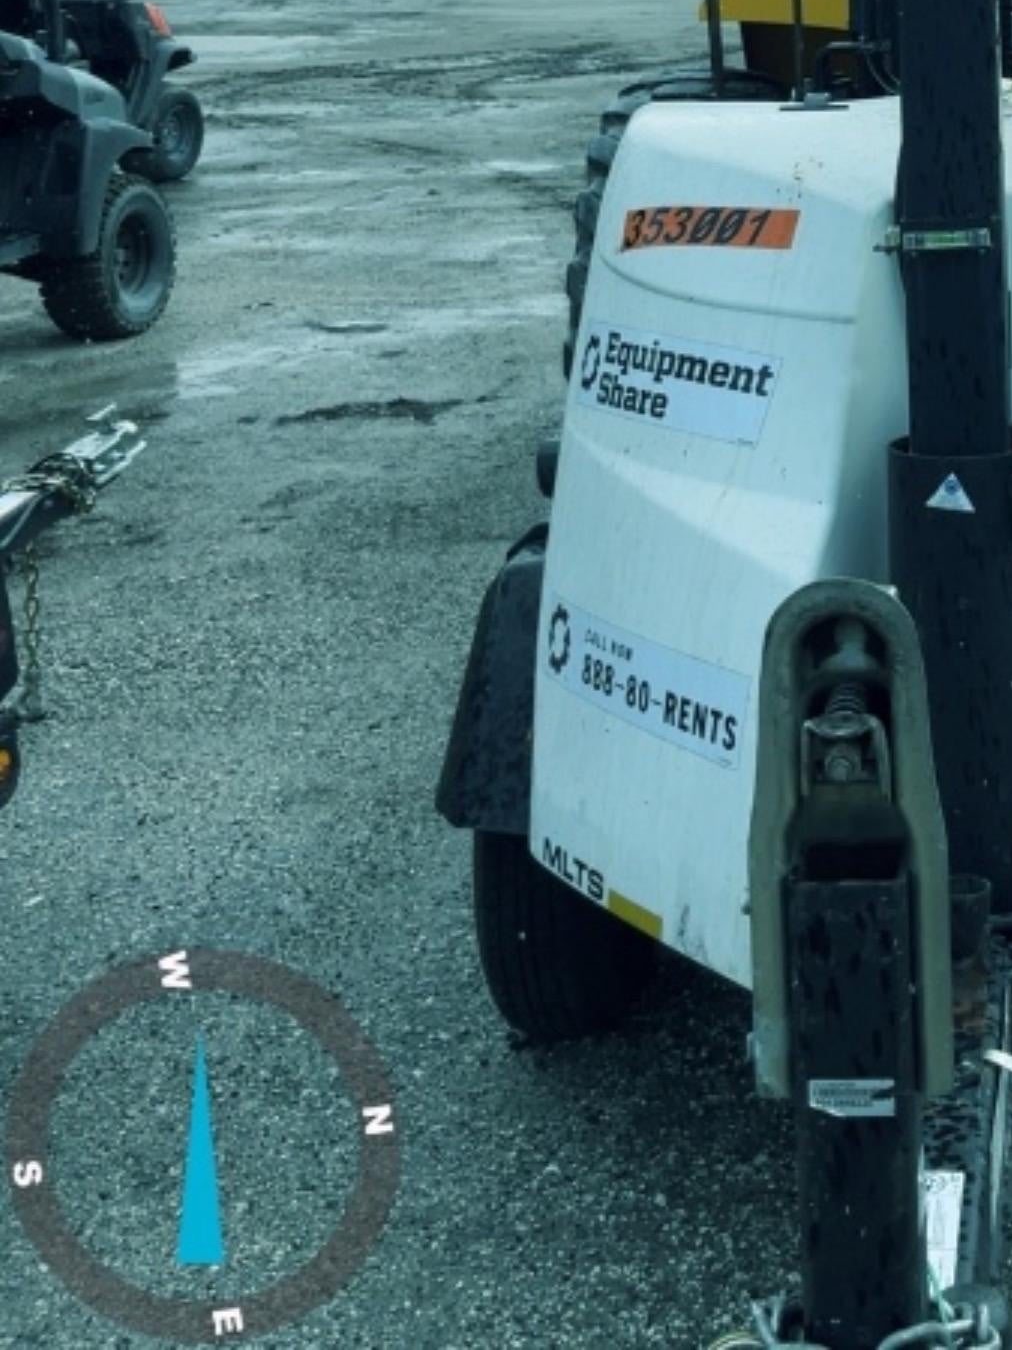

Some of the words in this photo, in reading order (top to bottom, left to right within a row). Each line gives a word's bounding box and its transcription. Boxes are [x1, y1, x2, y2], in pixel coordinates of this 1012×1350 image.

[621, 207, 772, 249] 353001
[595, 372, 669, 418] Share
[604, 331, 774, 397] Equipment
[582, 654, 738, 750] 888-80-RENTS
[542, 837, 605, 900] MLTS
